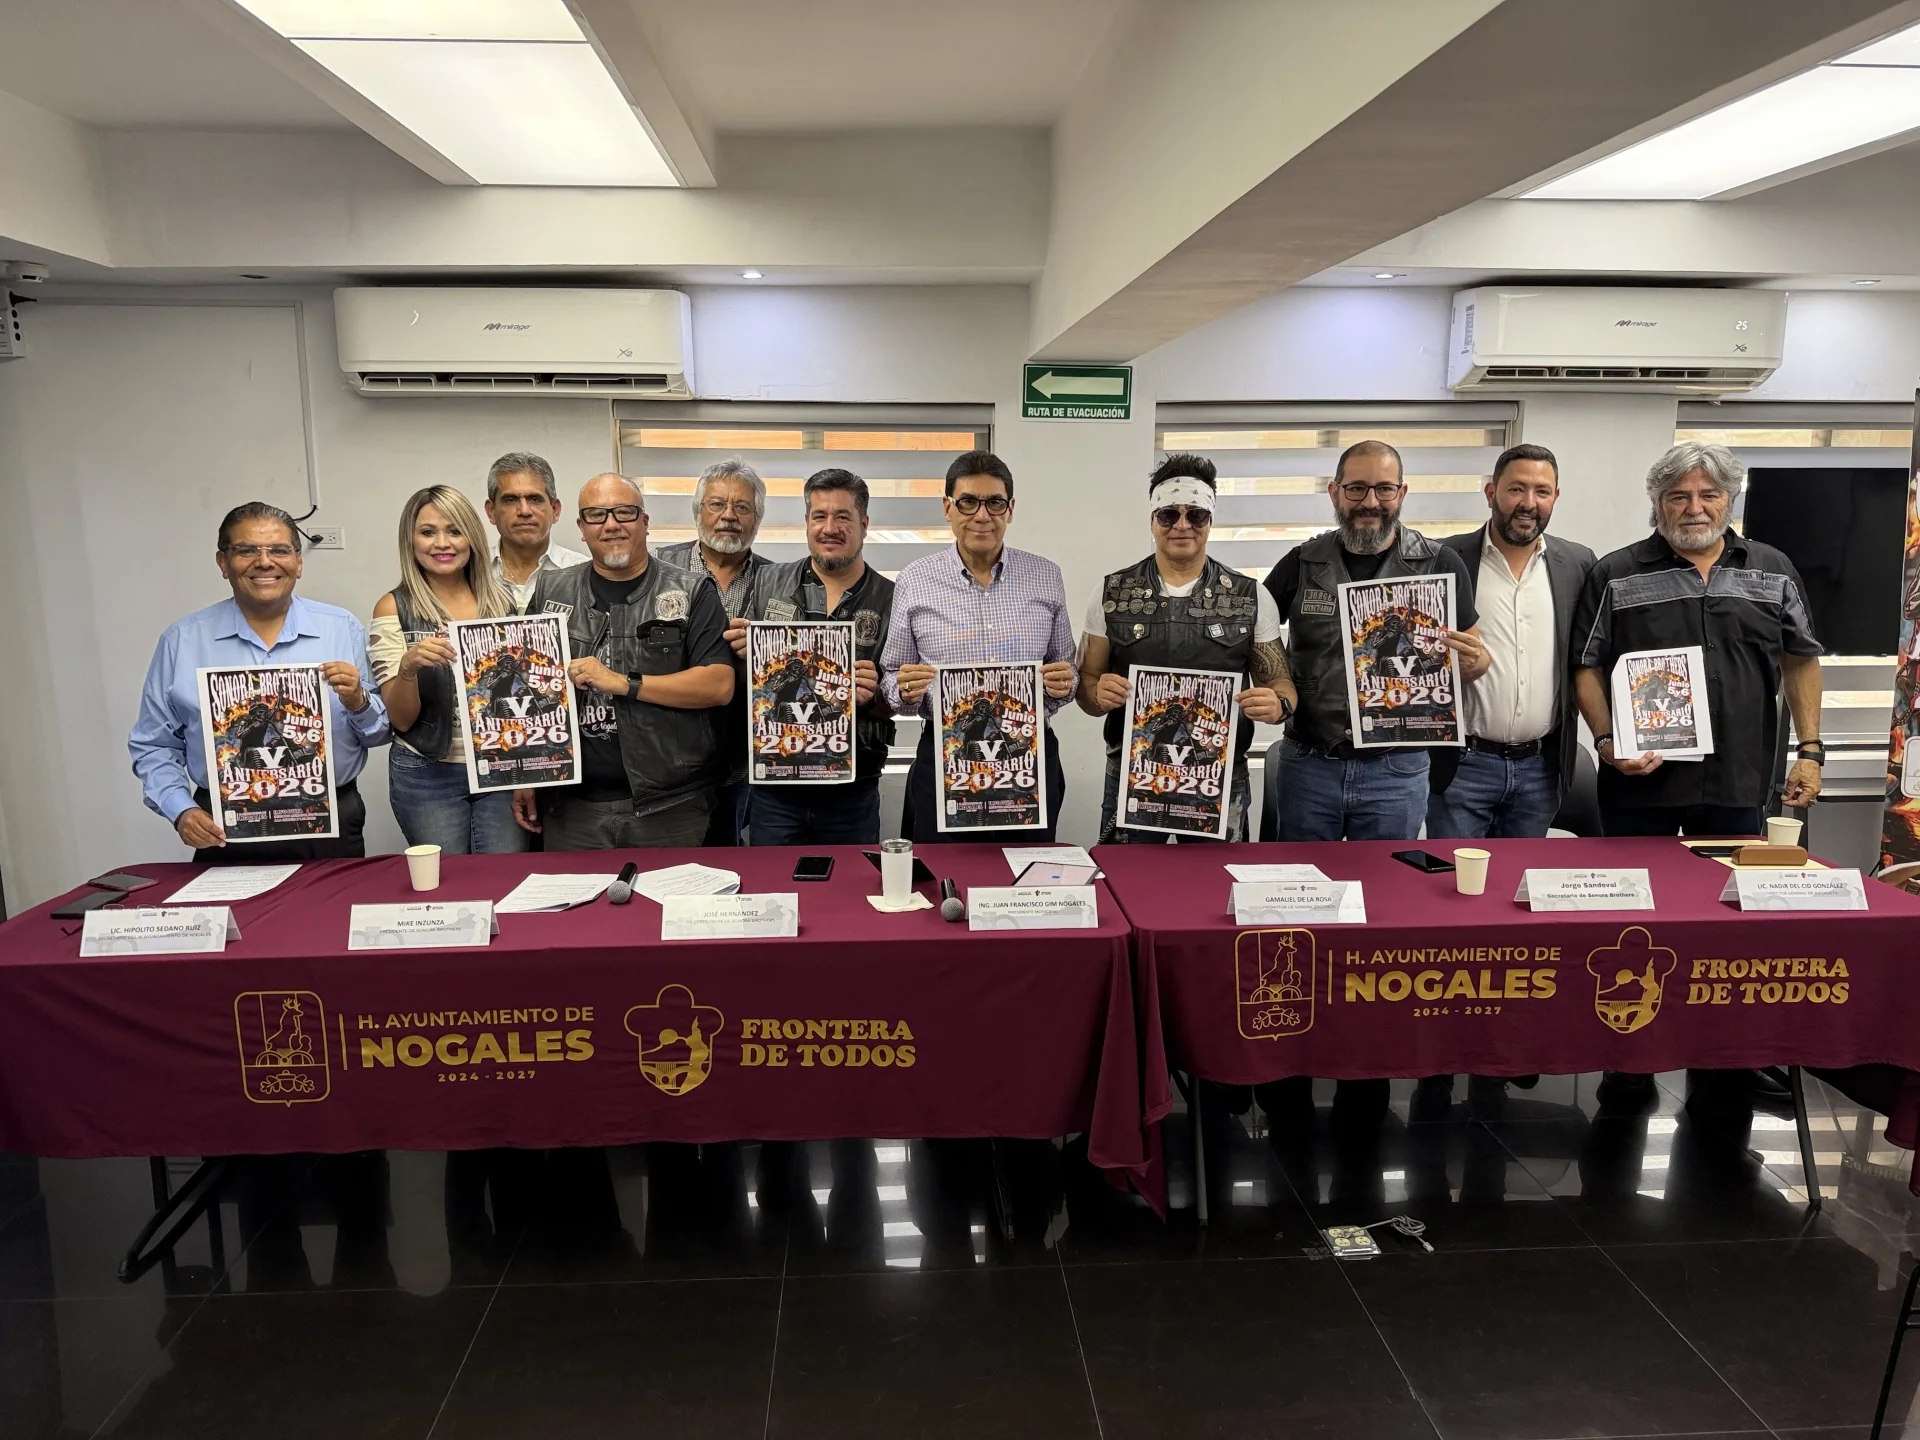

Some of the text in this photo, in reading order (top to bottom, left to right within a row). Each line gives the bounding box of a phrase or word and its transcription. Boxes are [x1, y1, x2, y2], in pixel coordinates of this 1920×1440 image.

[1028, 406, 1125, 418] RUTA DE EVACUACIÓN
[548, 601, 572, 614] MIKE
[1350, 580, 1446, 633] SONORA BROTHERS
[1413, 624, 1447, 638] Junio
[461, 620, 559, 672] SONORA BROTHERS
[753, 626, 850, 676] SONORA BROTHERS
[528, 663, 563, 678] Junio
[1389, 655, 1420, 677] V
[816, 669, 850, 686] Junio
[1360, 667, 1450, 691] ANIVERSARIO
[210, 668, 318, 721] SONORA BROTHERS
[942, 666, 1033, 717] SONORA BROTHERS
[1136, 672, 1231, 722] SONORA BROTHERS
[1365, 686, 1452, 707] 2026
[504, 696, 534, 718] V
[787, 702, 818, 725] V
[1002, 708, 1036, 723] Junio
[1652, 698, 1671, 711] V
[283, 713, 322, 728] Junio
[476, 704, 566, 733] ANIVERSARIO
[757, 714, 849, 736] ANIVERSARIO
[1194, 716, 1228, 735] Junio
[1638, 716, 1693, 729] 2026
[481, 725, 569, 750] 2026
[760, 734, 849, 753] 2026
[256, 747, 288, 768] V
[976, 740, 1005, 761] V
[1165, 743, 1194, 767] V
[222, 756, 323, 784] ANIVERSARIO
[947, 750, 1035, 775] ANIVERSARIO
[1132, 754, 1222, 780] ANIVERSARIO
[227, 777, 325, 800] 2026
[950, 770, 1036, 790] 2026
[1133, 772, 1221, 797] 2026
[703, 910, 718, 918] JOSÉ
[1346, 947, 1561, 964] H. AYUNTAMIENTO DE
[1690, 957, 1849, 978] FRONTERA
[1345, 968, 1557, 1002] NOGALES
[1686, 981, 1849, 1004] DE TODOS
[358, 1006, 594, 1029] H. AYUNTAMIENTO DE
[1413, 1007, 1449, 1017] 2024
[1464, 1006, 1502, 1015] 2027
[740, 1018, 914, 1040] FRONTERA
[361, 1029, 595, 1068] NOGALES
[740, 1043, 916, 1068] DE TODOS
[438, 1072, 479, 1082] 2024
[495, 1070, 537, 1080] 2027
